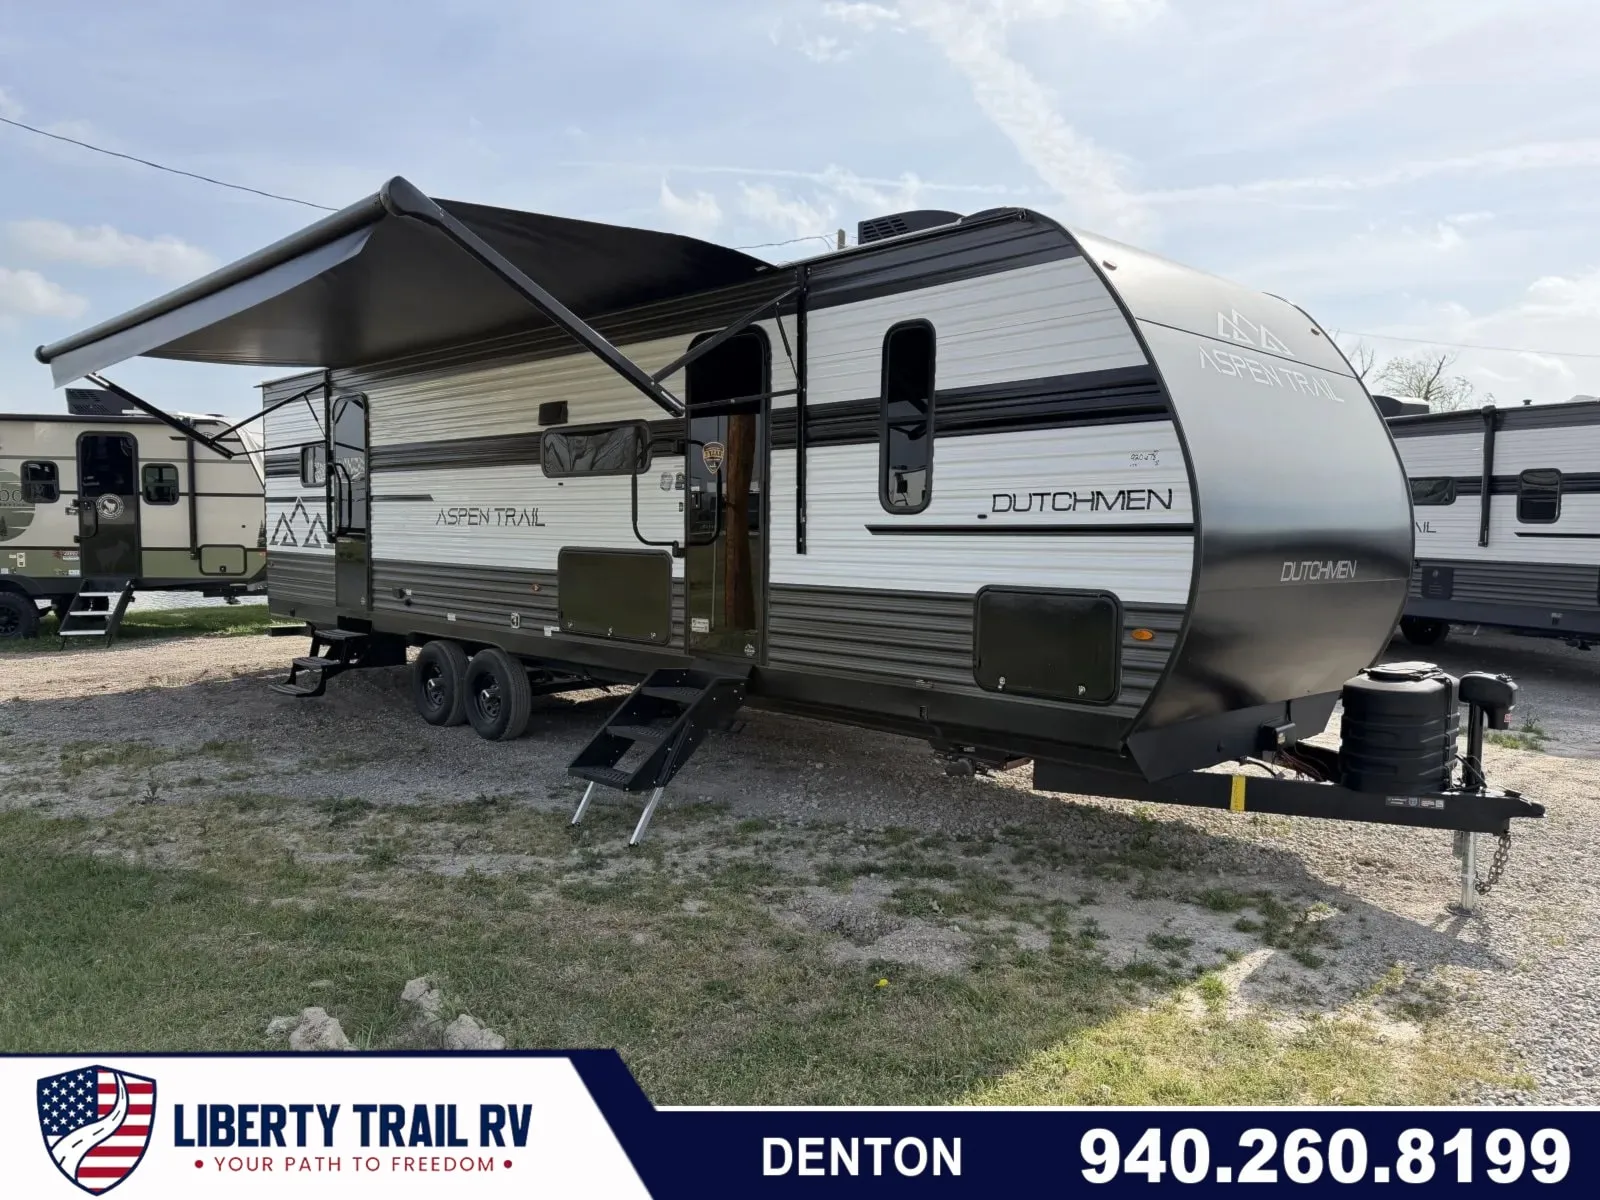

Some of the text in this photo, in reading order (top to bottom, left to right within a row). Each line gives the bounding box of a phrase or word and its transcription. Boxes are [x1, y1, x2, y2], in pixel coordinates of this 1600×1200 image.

[1199, 346, 1345, 403] ASPEN TRAIL
[991, 488, 1173, 513] DUTCHMEN
[435, 507, 546, 527] ASPEN TRAIL
[1280, 560, 1357, 582] DUTCHMEN
